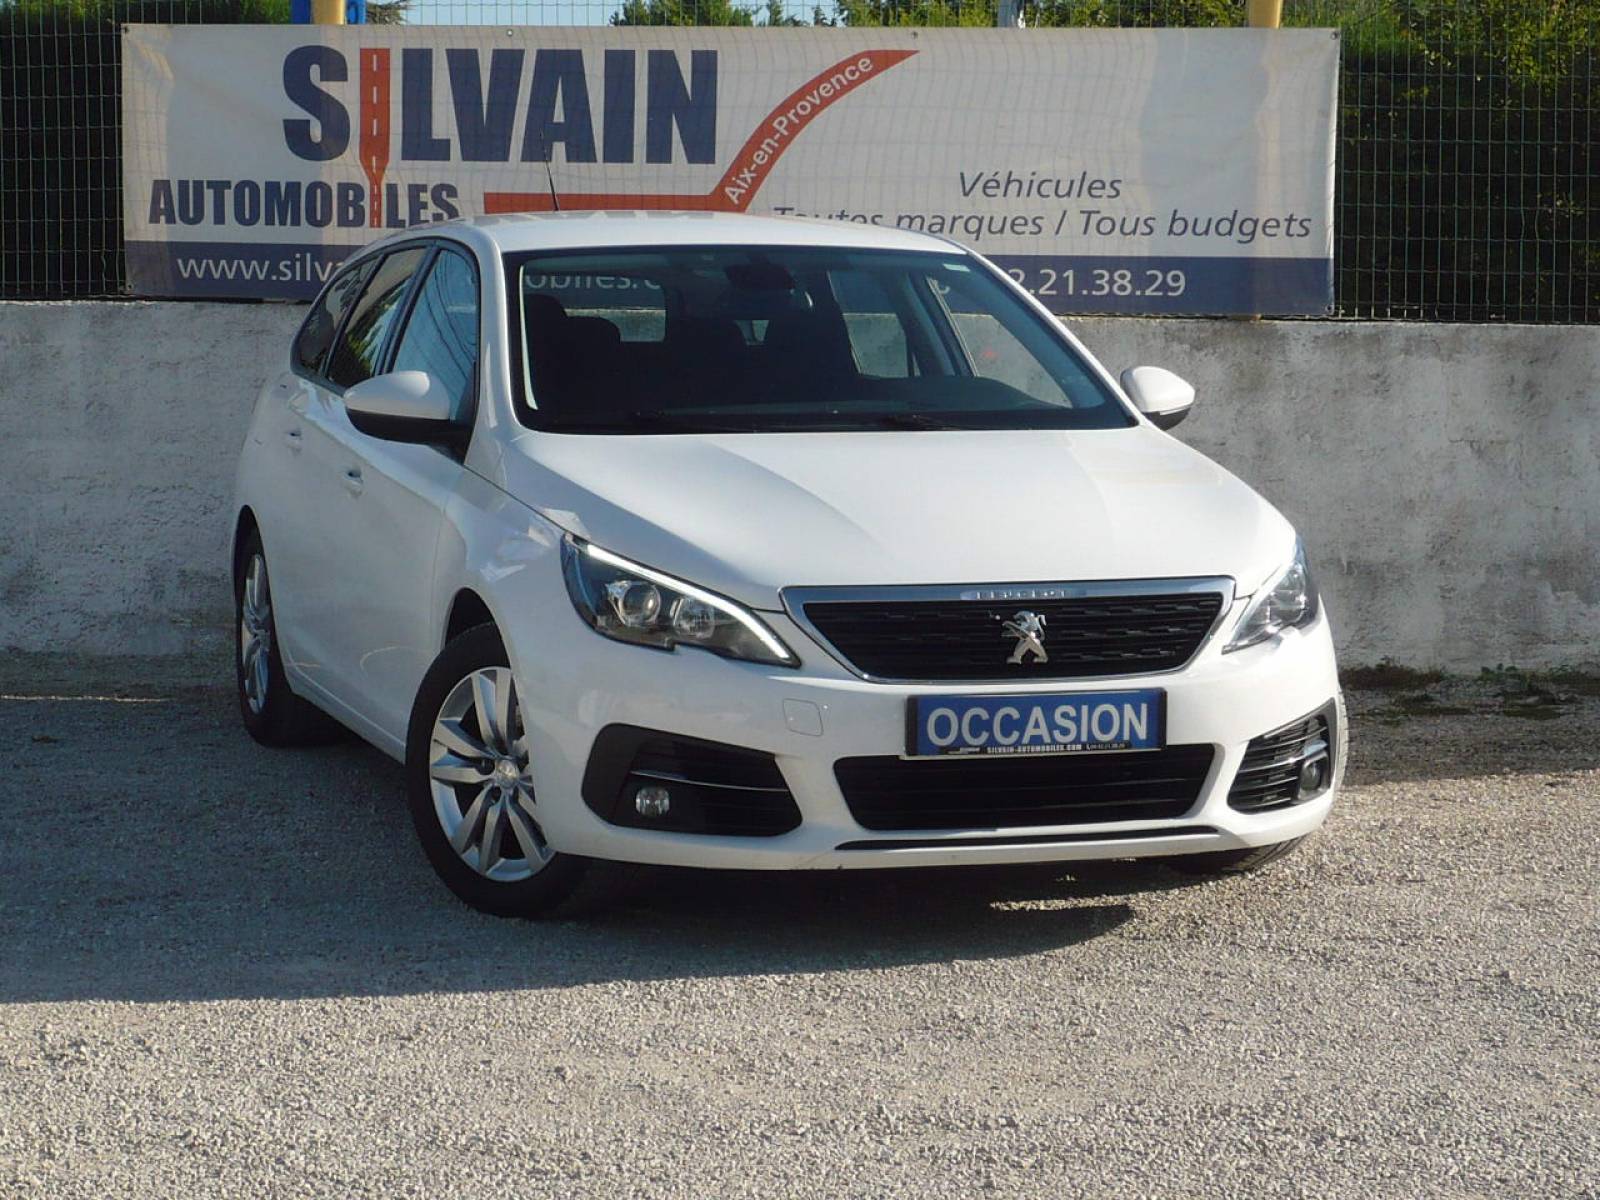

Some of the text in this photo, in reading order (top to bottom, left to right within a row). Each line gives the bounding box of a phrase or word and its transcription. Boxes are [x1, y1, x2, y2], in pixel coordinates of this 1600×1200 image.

[283, 44, 718, 164] SILVAIN
[724, 56, 874, 205] Aix-en-Provence
[148, 178, 460, 229] AUTOMOBILES
[958, 170, 1123, 199] Véhicules
[895, 212, 1046, 241] marques
[1079, 209, 1157, 237] Tous
[1166, 208, 1313, 245] budgets
[926, 702, 1148, 746] OCCASION
